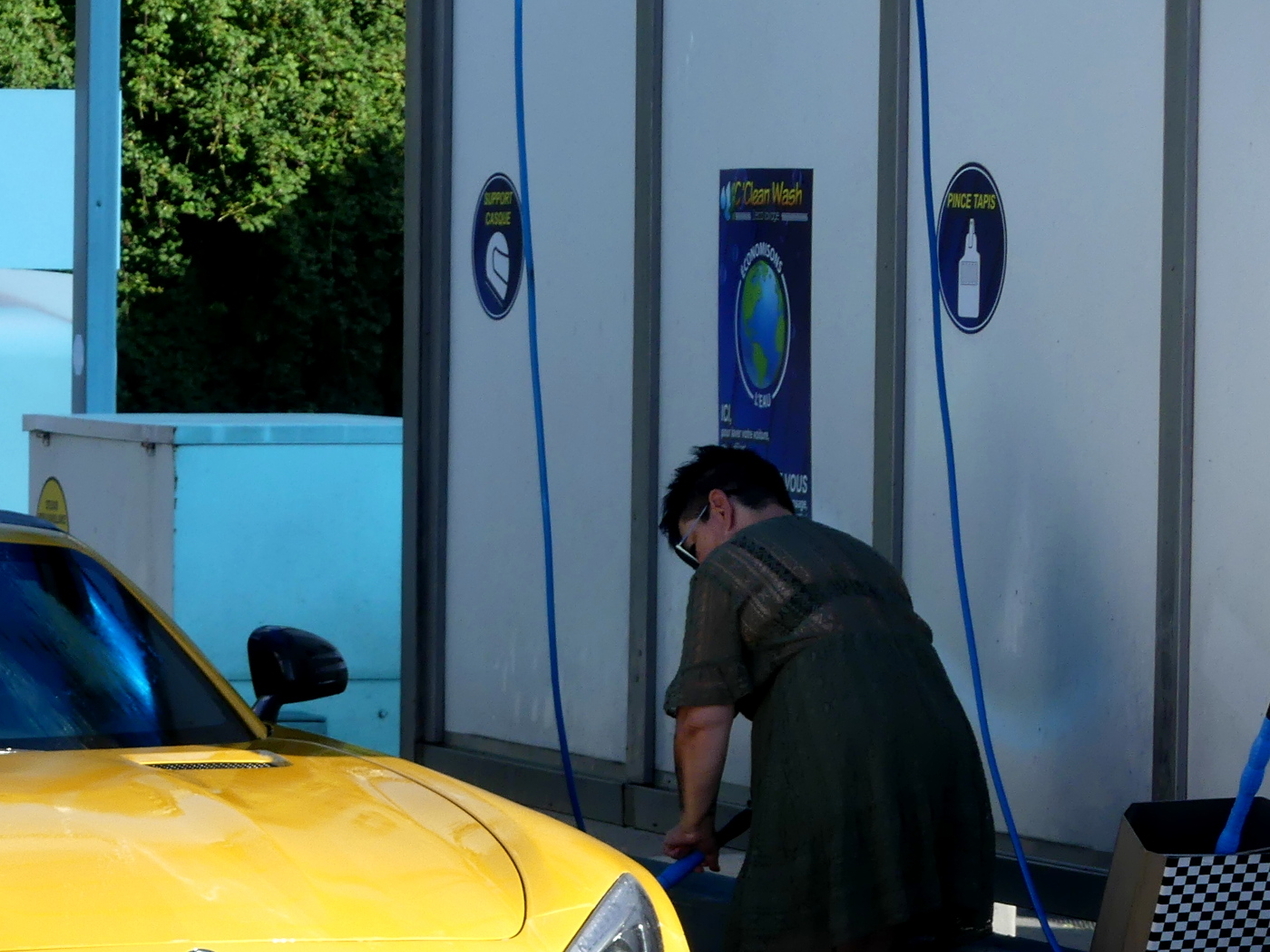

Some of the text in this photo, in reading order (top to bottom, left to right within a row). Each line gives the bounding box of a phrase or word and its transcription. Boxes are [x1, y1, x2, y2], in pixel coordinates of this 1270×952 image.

[484, 191, 513, 205] SUPPORT
[772, 181, 802, 205] Wash
[947, 193, 996, 209] PINCE TAPIS
[485, 211, 511, 225] CASQUE
[784, 473, 808, 493] VOUS
